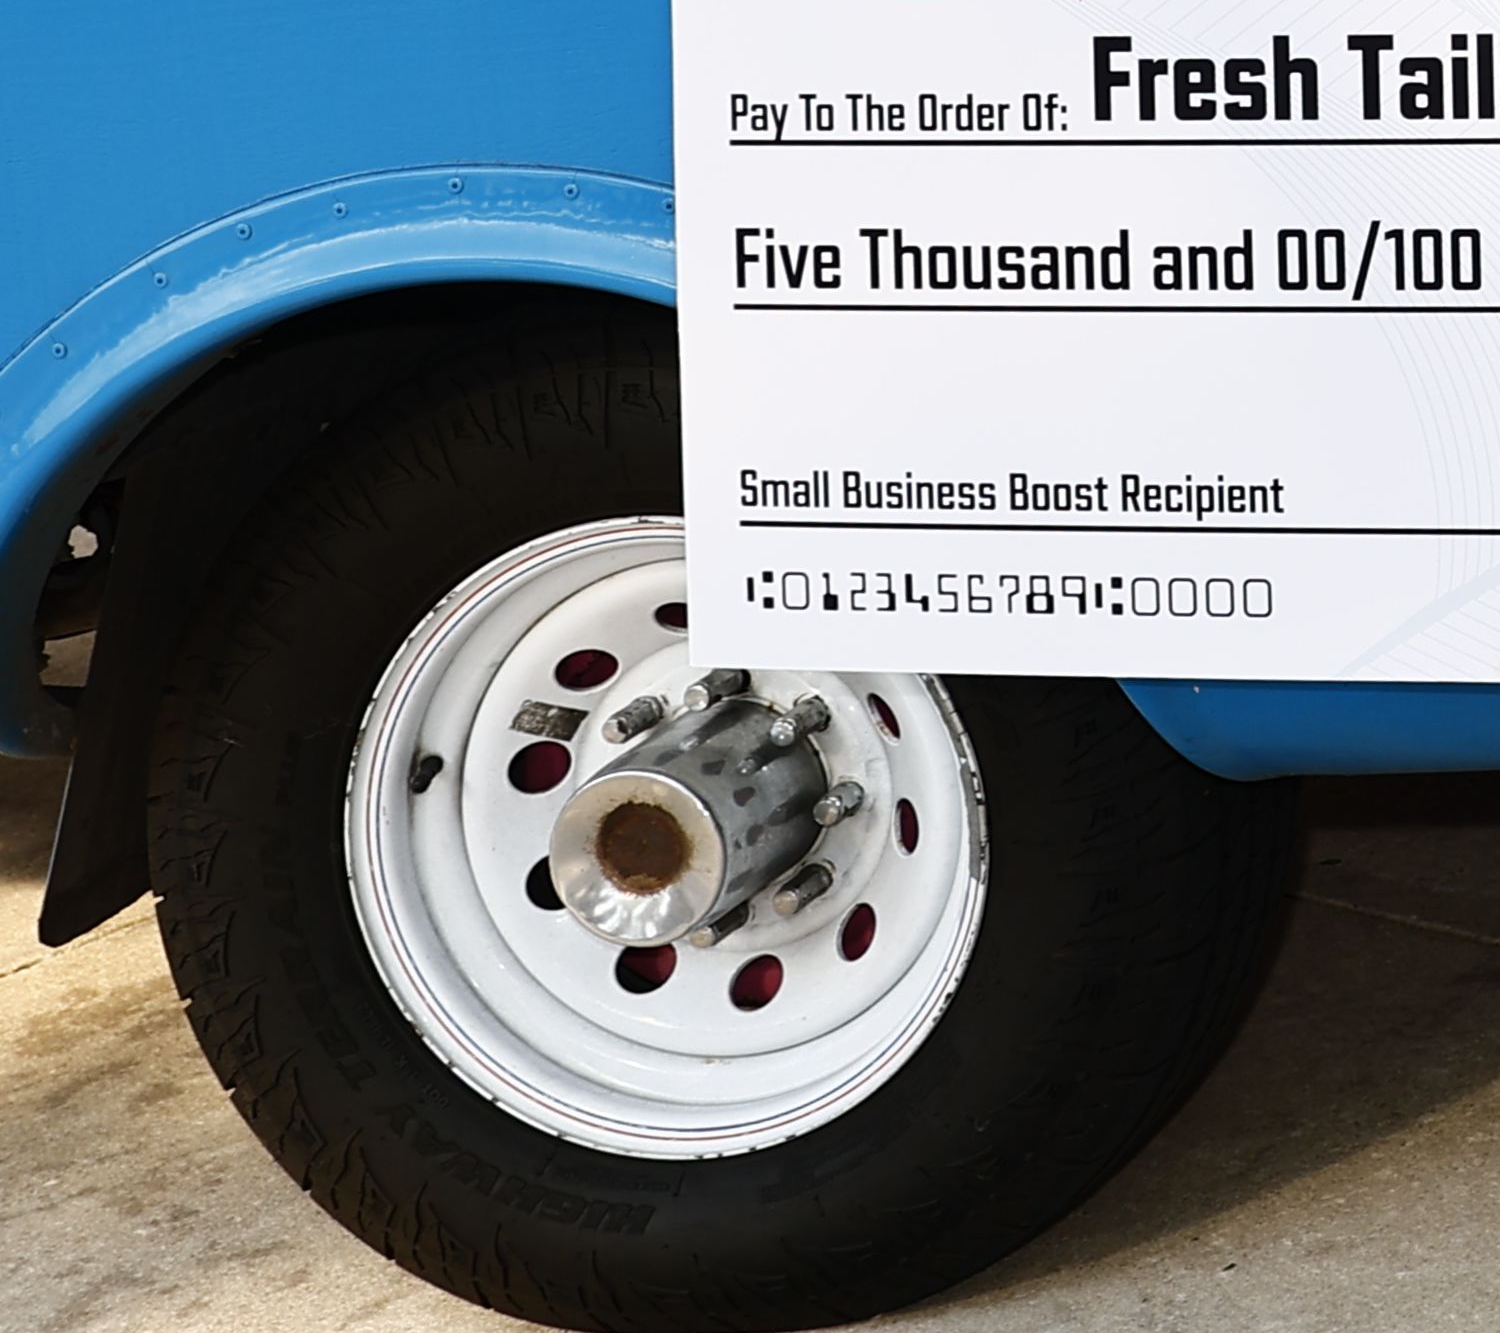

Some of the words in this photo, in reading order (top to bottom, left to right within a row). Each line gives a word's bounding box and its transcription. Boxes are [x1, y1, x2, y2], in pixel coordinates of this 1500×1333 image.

[730, 93, 788, 141] Pay
[798, 93, 834, 132] To
[845, 93, 905, 132] The
[918, 93, 1010, 132] Order
[1022, 93, 1068, 132] Of:
[1092, 34, 1319, 122] Fresh
[735, 227, 841, 289] Five
[859, 228, 1130, 291] Thousand
[1153, 228, 1254, 291] and
[1277, 220, 1482, 301] 00/100
[740, 469, 830, 508] Small
[842, 470, 996, 511] Business
[1009, 472, 1109, 512] Boost
[1121, 474, 1285, 521] Recipient
